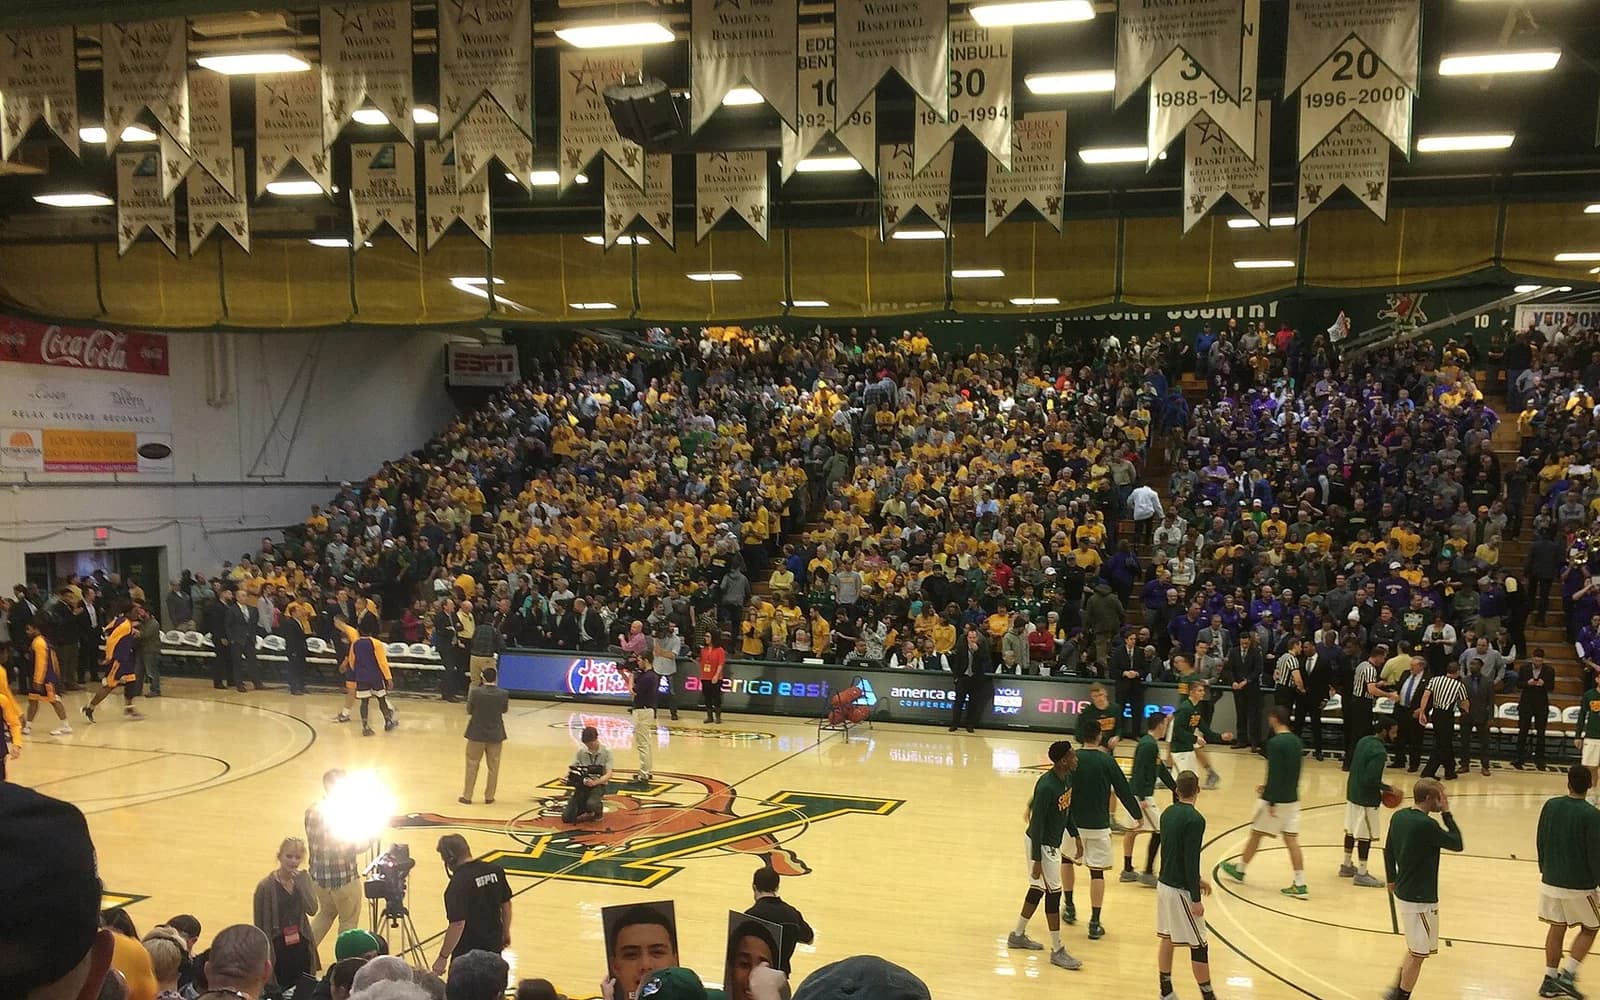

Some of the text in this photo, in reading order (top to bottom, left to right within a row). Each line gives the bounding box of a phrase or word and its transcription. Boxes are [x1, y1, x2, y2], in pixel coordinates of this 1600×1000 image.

[864, 3, 918, 16] WOMEN'S
[719, 14, 770, 25] WOMEN'S
[857, 17, 924, 33] BASKETBALL
[462, 32, 510, 44] WOMEN'S
[712, 29, 776, 40] BASKETBALL
[952, 28, 989, 44] HERI
[340, 50, 395, 61] BASKETBALL
[457, 48, 514, 59] BASKETBALL
[1331, 48, 1379, 81] 20
[1155, 86, 1252, 108] 1988-192
[1304, 86, 1405, 108] 1996-2000
[920, 105, 1009, 125] 190-1994
[1026, 130, 1052, 140] EAST
[1030, 140, 1052, 150] 2010
[1015, 154, 1050, 163] OMEN'S
[1311, 147, 1377, 158] BASKETBALL
[996, 163, 1056, 175] BKETBALL
[1328, 169, 1385, 180] TOURNAMENT
[704, 174, 758, 183] BASKETBALL
[903, 190, 948, 199] TOURNAMEN
[1475, 314, 1490, 328] 10
[1055, 322, 1064, 335] 6
[41, 325, 128, 370] Coca-Cola
[454, 352, 514, 373] ESPN
[778, 680, 829, 698] east
[890, 687, 945, 700] america
[997, 688, 1020, 697] YOU
[993, 706, 1020, 715] PLAY
[475, 873, 498, 888] ESPN
